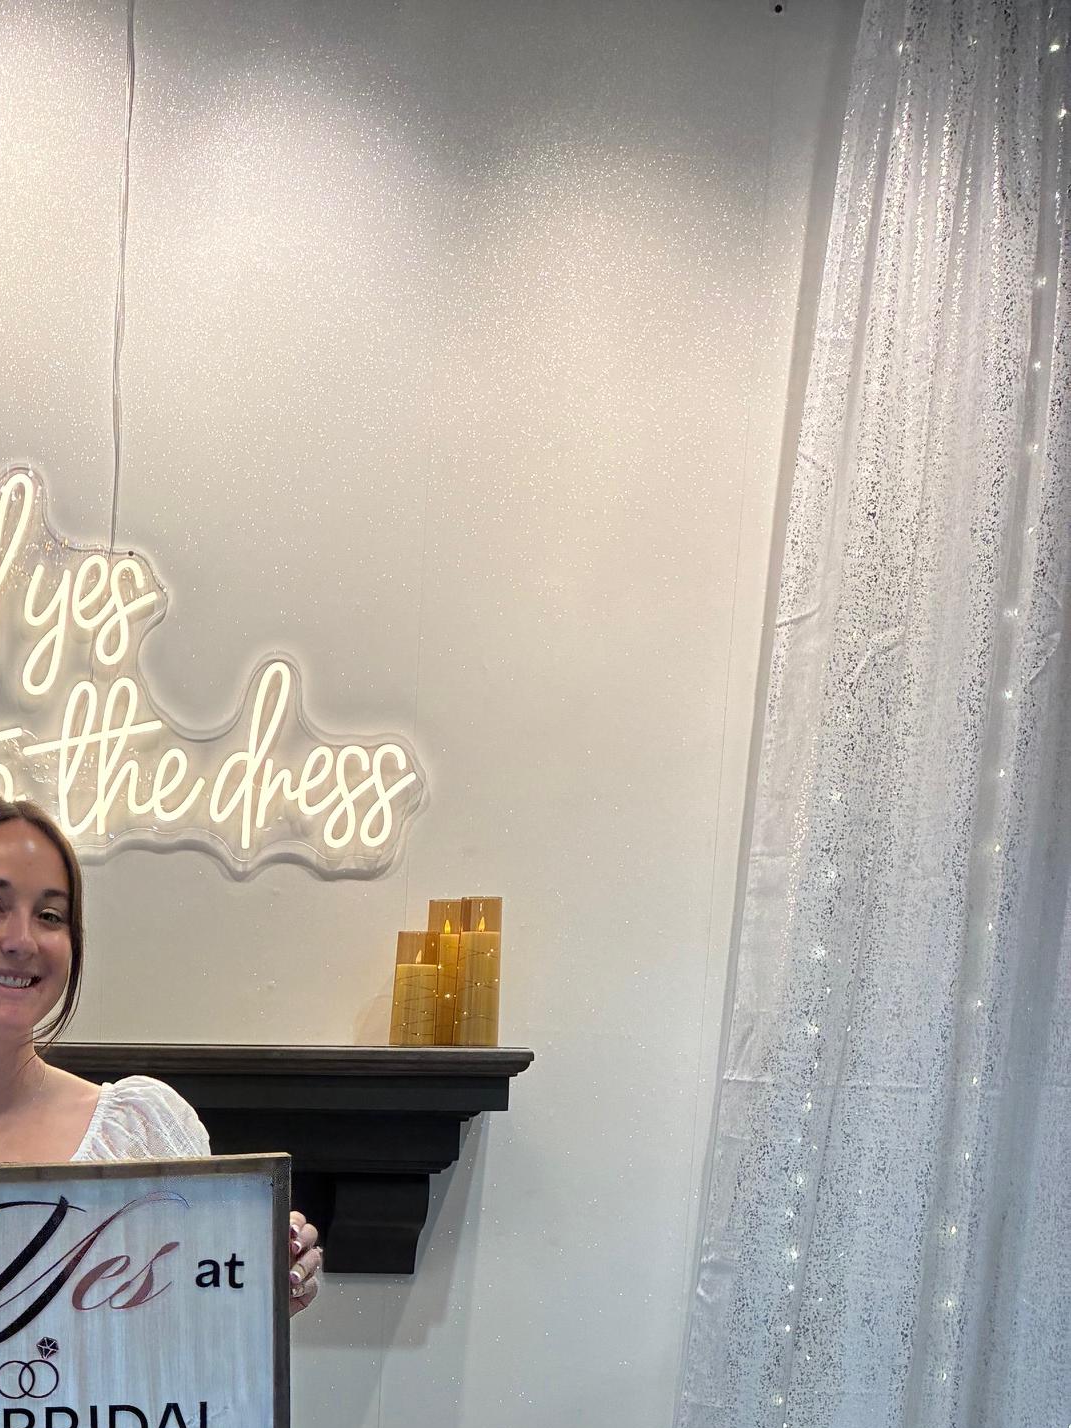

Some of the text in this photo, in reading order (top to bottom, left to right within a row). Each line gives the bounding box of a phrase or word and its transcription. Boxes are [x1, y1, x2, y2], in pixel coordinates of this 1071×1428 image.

[22, 553, 158, 696] yes
[22, 677, 207, 837] the
[209, 660, 417, 850] dress
[195, 1252, 245, 1290] at
